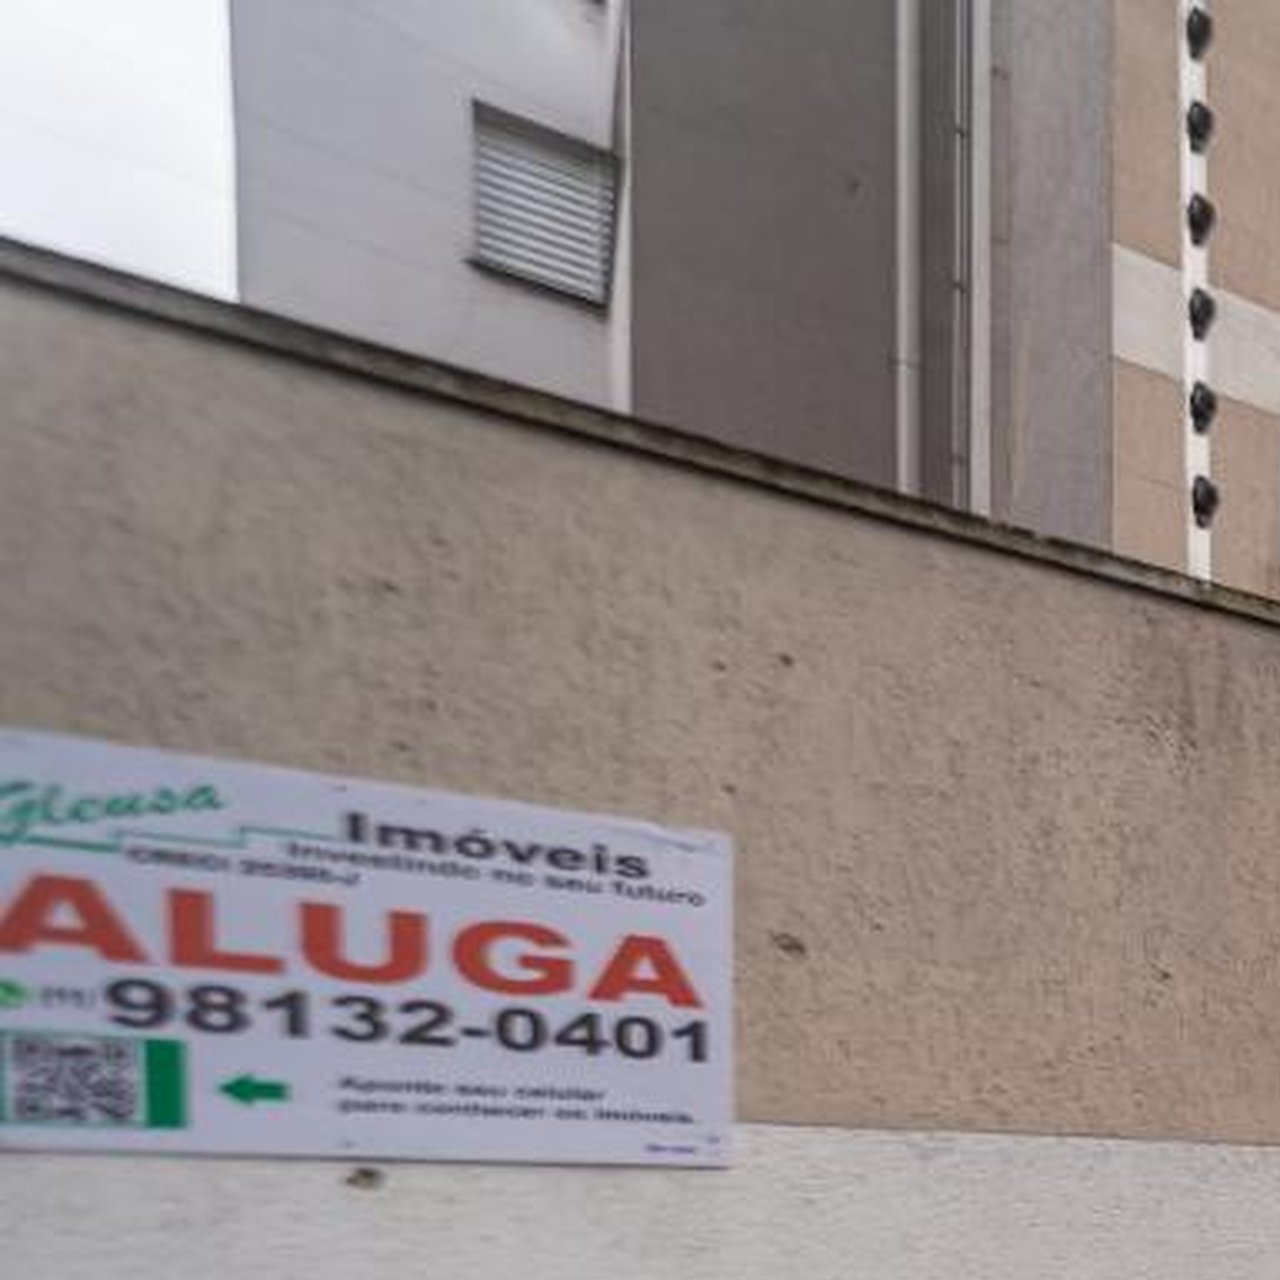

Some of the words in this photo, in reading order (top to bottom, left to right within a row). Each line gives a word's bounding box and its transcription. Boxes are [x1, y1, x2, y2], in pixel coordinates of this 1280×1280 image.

[345, 811, 652, 880] Imóveis
[0, 870, 706, 1010] ALUGA
[105, 978, 712, 1063] 98132-0401
